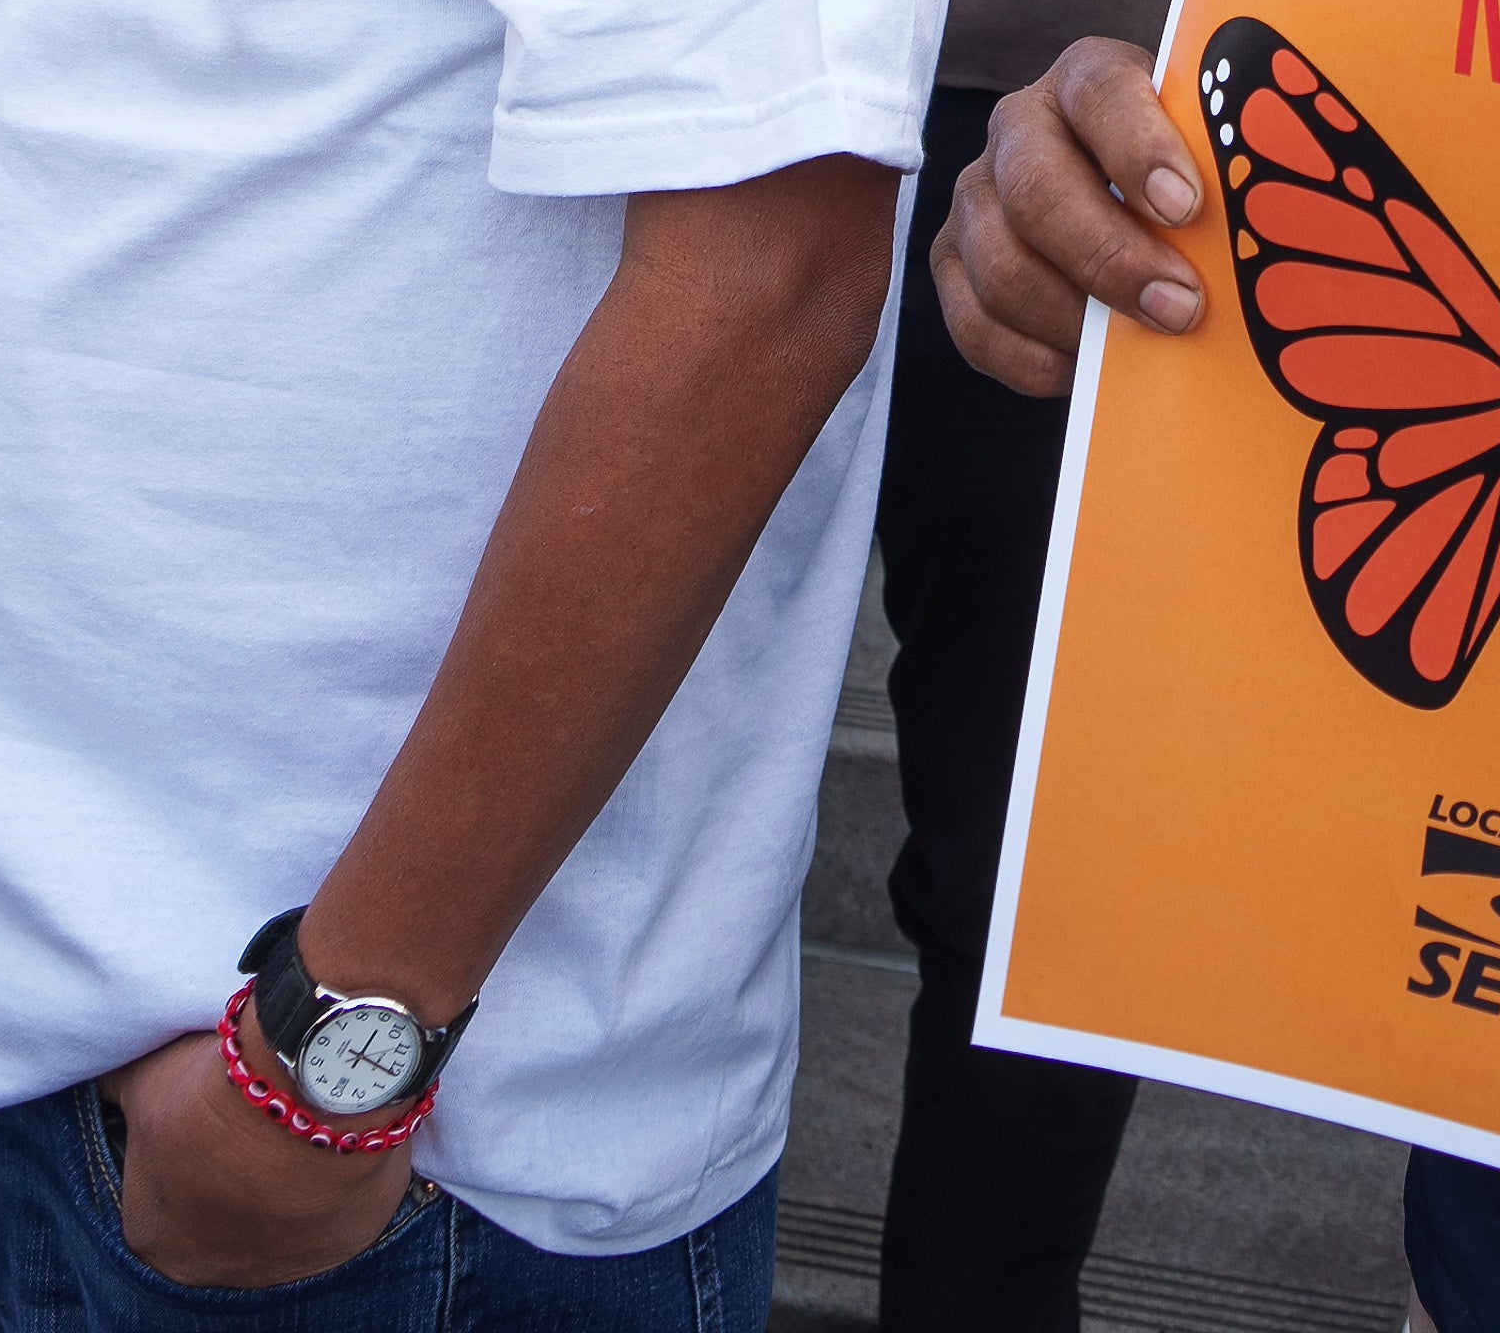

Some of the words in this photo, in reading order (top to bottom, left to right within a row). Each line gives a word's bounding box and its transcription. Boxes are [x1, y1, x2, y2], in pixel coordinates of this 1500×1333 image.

[355, 1011, 369, 1022] 8
[377, 1011, 391, 1023] 9
[334, 1019, 348, 1031] 7
[387, 1022, 407, 1040] 10
[317, 1035, 331, 1048] 6
[393, 1041, 411, 1056] 11
[310, 1055, 324, 1068] 5
[315, 1074, 328, 1085] 4
[372, 1081, 386, 1090] 1
[329, 1086, 344, 1098] 3
[351, 1088, 366, 1100] 2
